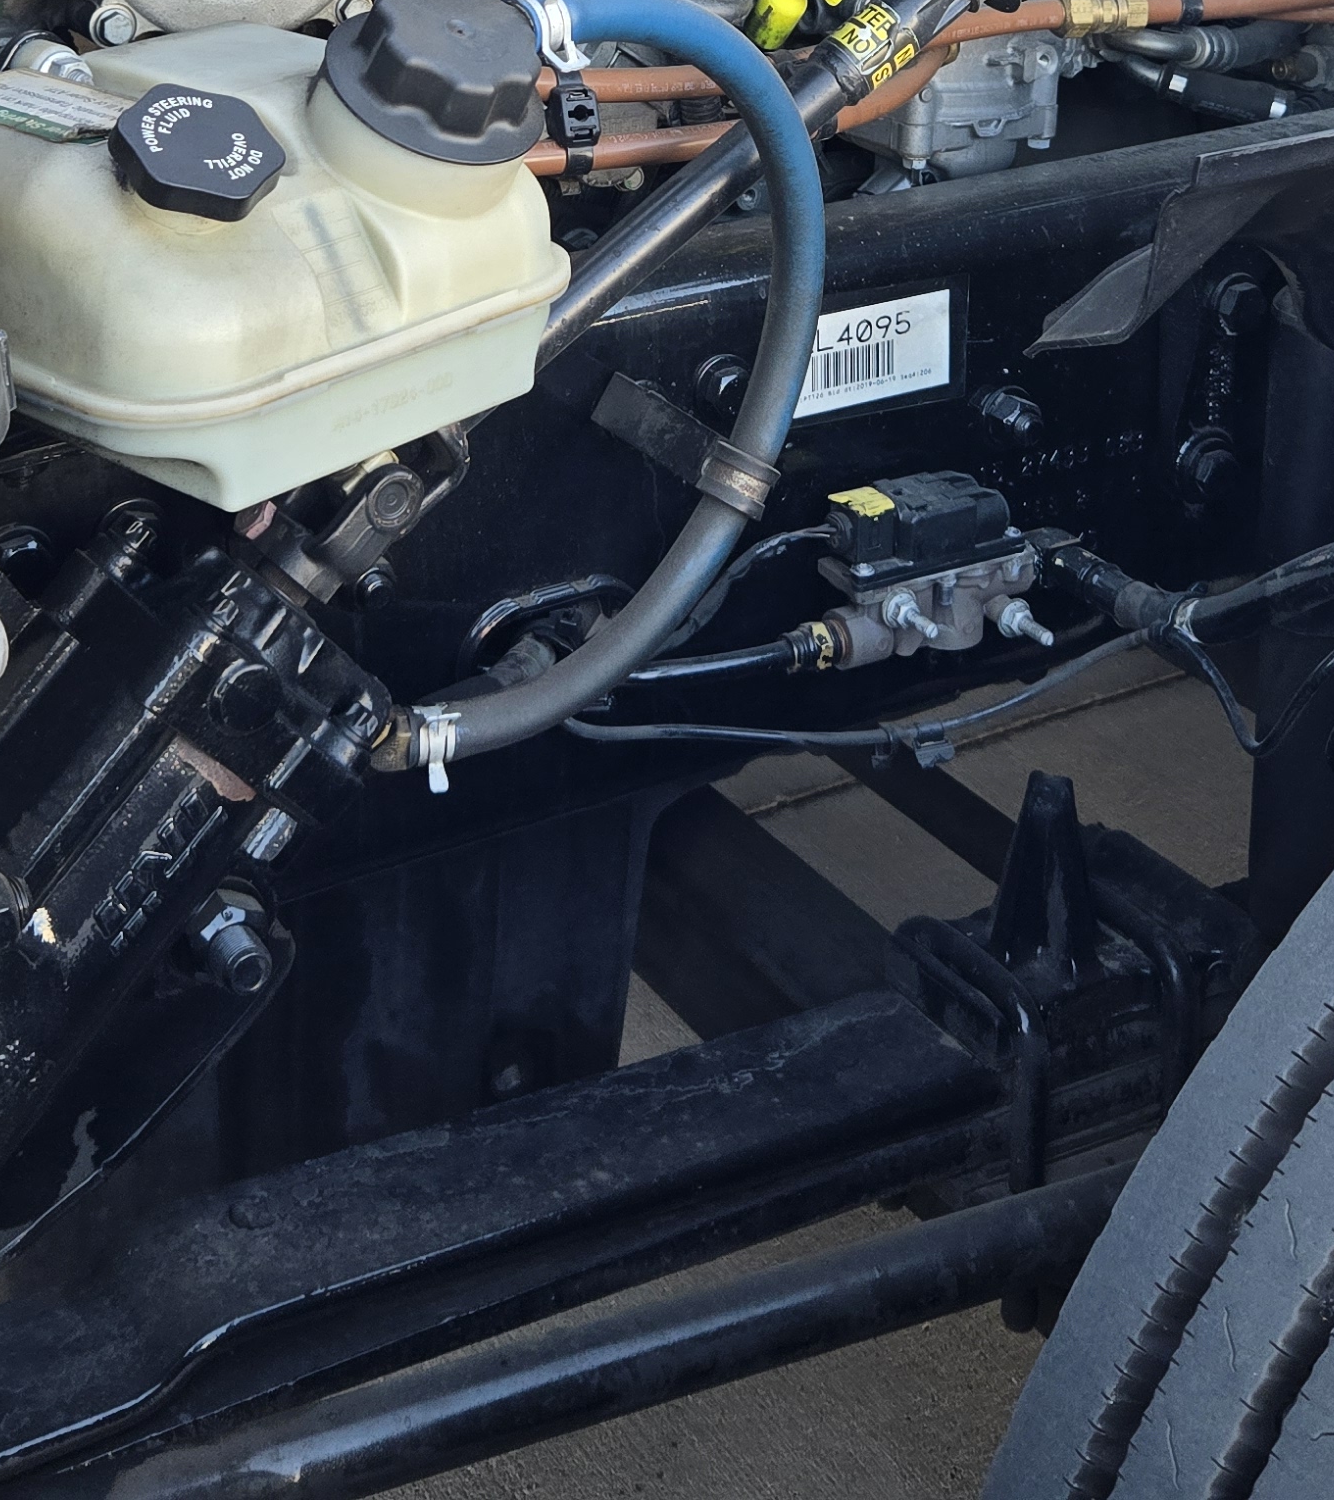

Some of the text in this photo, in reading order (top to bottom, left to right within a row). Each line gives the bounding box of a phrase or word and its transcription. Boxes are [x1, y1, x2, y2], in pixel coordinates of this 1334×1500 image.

[141, 96, 213, 153] POWER STEERING
[158, 108, 191, 134] FLUID
[203, 132, 247, 170] OVERFILL
[228, 149, 264, 181] DO NOT
[812, 310, 912, 354] L4095
